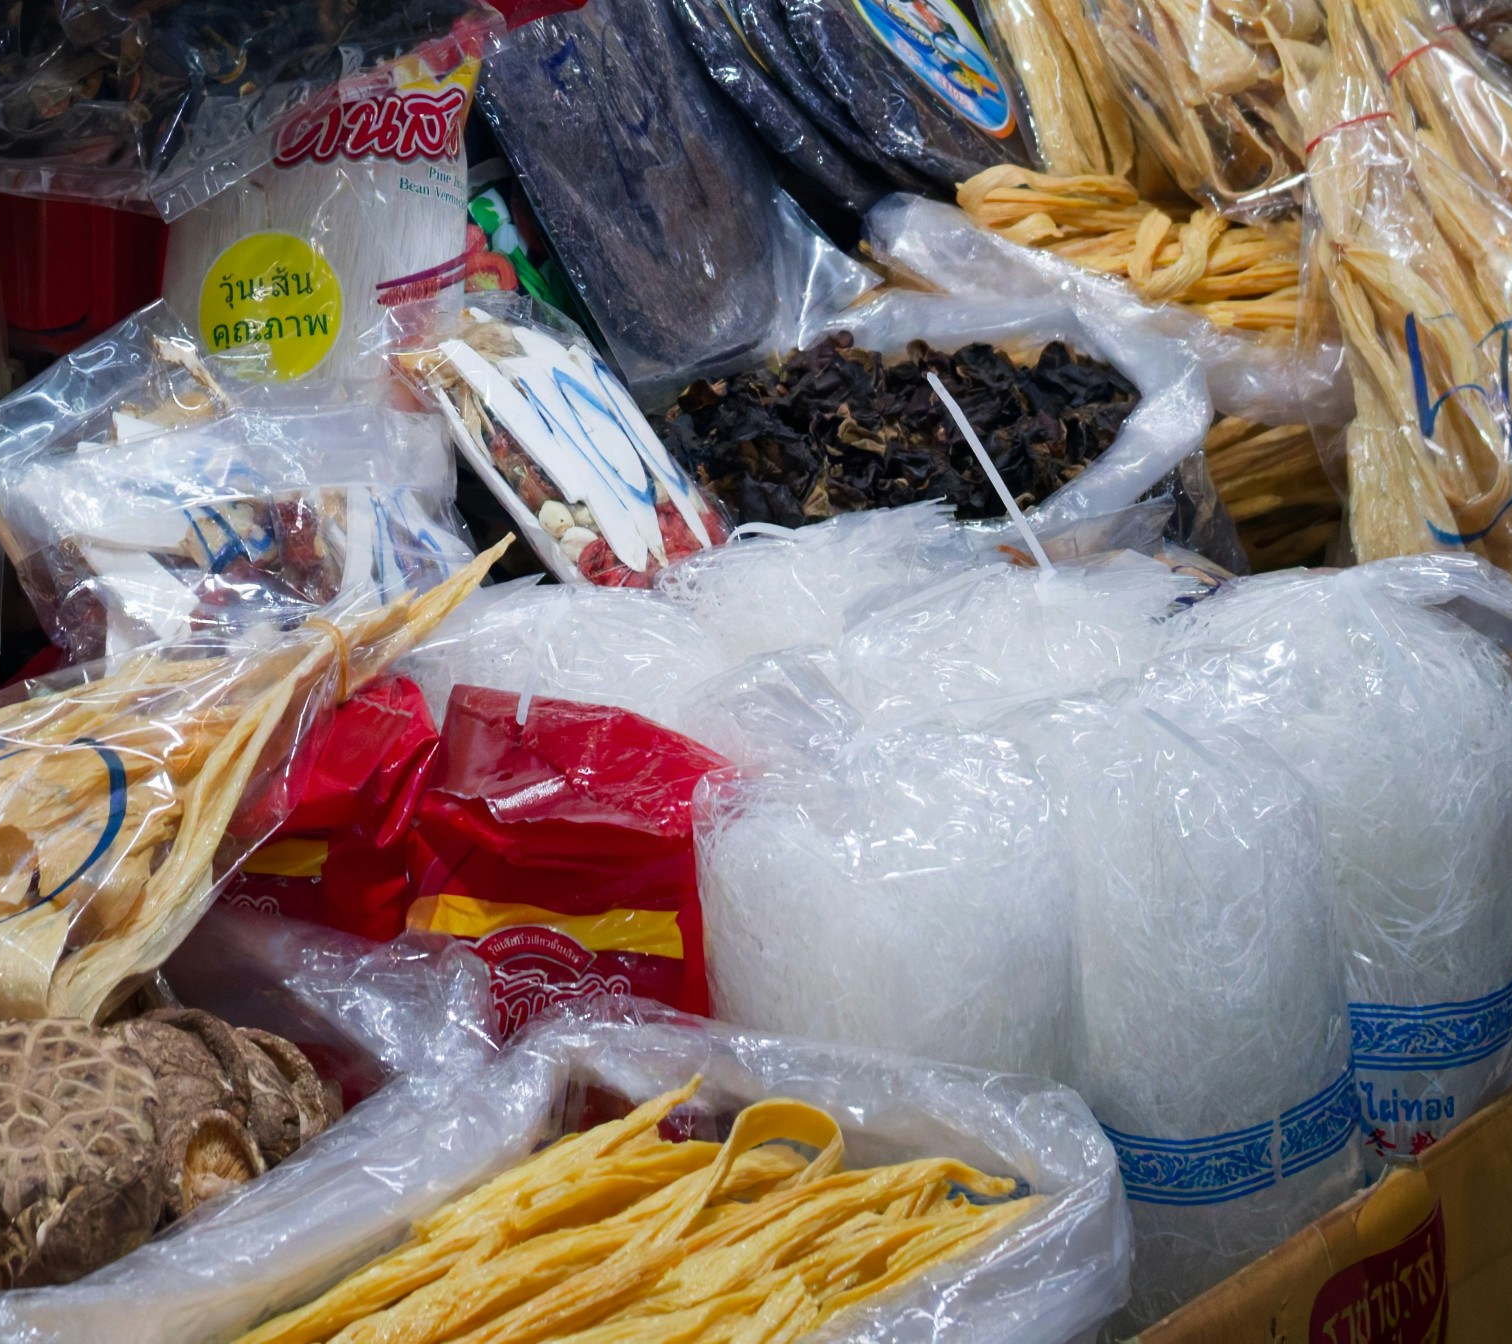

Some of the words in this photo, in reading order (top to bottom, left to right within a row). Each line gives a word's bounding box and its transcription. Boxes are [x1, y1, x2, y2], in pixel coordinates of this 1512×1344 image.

[429, 165, 452, 184] Pine
[399, 176, 431, 197] Bean
[212, 311, 329, 350] คุณภาพ
